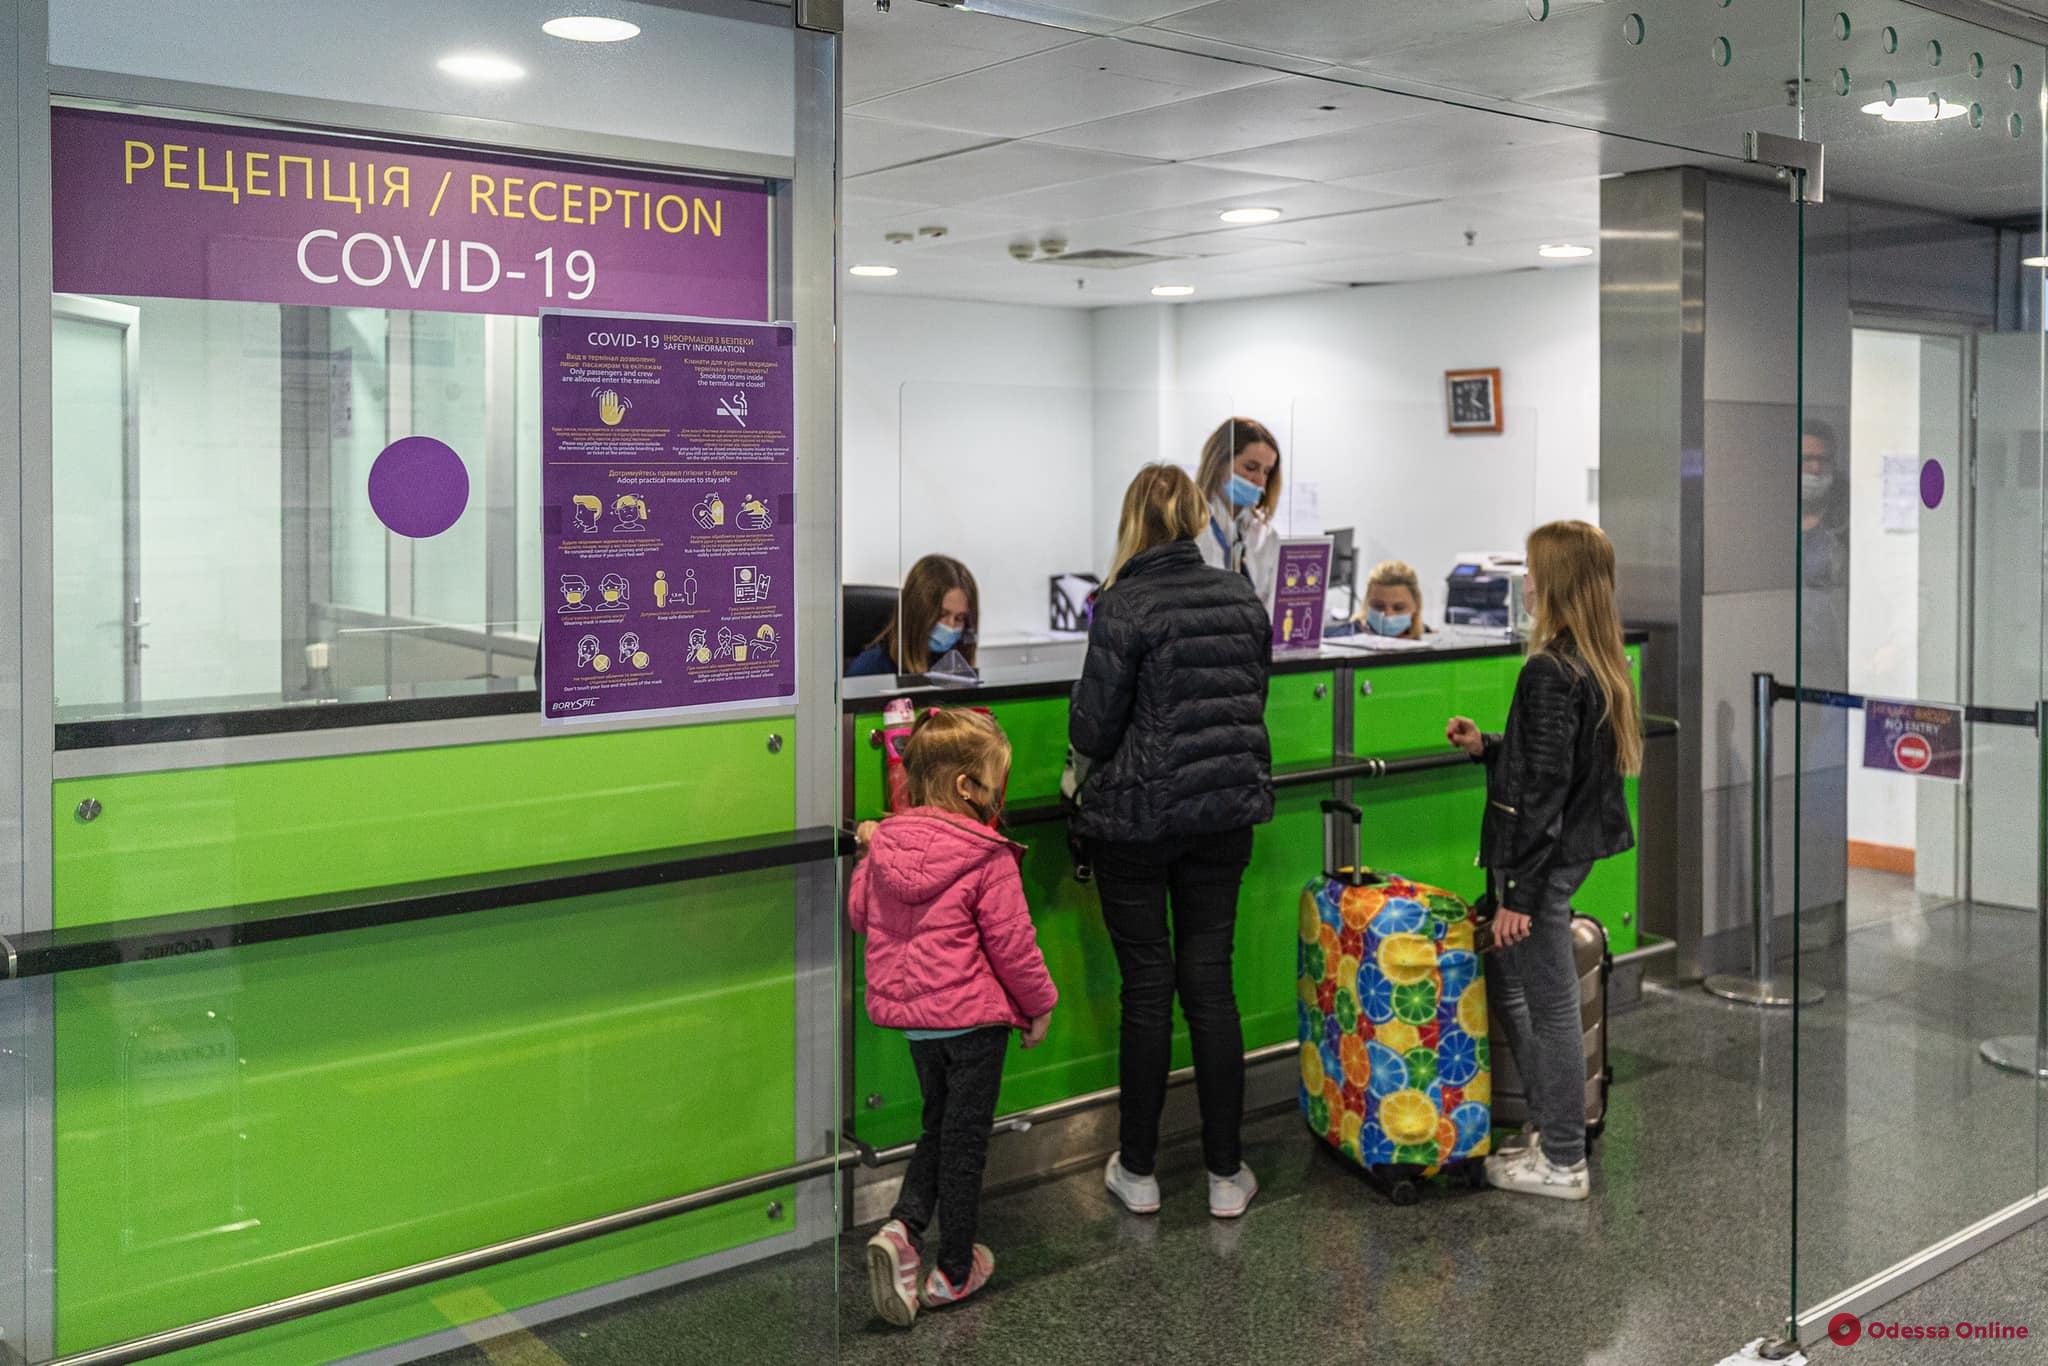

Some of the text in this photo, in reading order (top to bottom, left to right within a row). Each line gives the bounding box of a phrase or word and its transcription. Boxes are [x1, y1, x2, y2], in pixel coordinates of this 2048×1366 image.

[124, 140, 722, 237] РЕЦЕПЦІЯ / RECEPTION
[297, 229, 596, 301] COVID-19
[588, 332, 659, 348] COVID-19
[663, 334, 714, 344] ІНФОРМАЦІЯ
[721, 337, 754, 345] БЕЗПЕКИ
[663, 342, 745, 353] SAFETY INFORMATION
[570, 368, 586, 376] Only
[587, 369, 622, 378] passengers
[699, 373, 726, 381] Smoking
[639, 477, 666, 485] practical
[552, 697, 600, 711] BORYSPIL
[1884, 718, 1903, 730] NO
